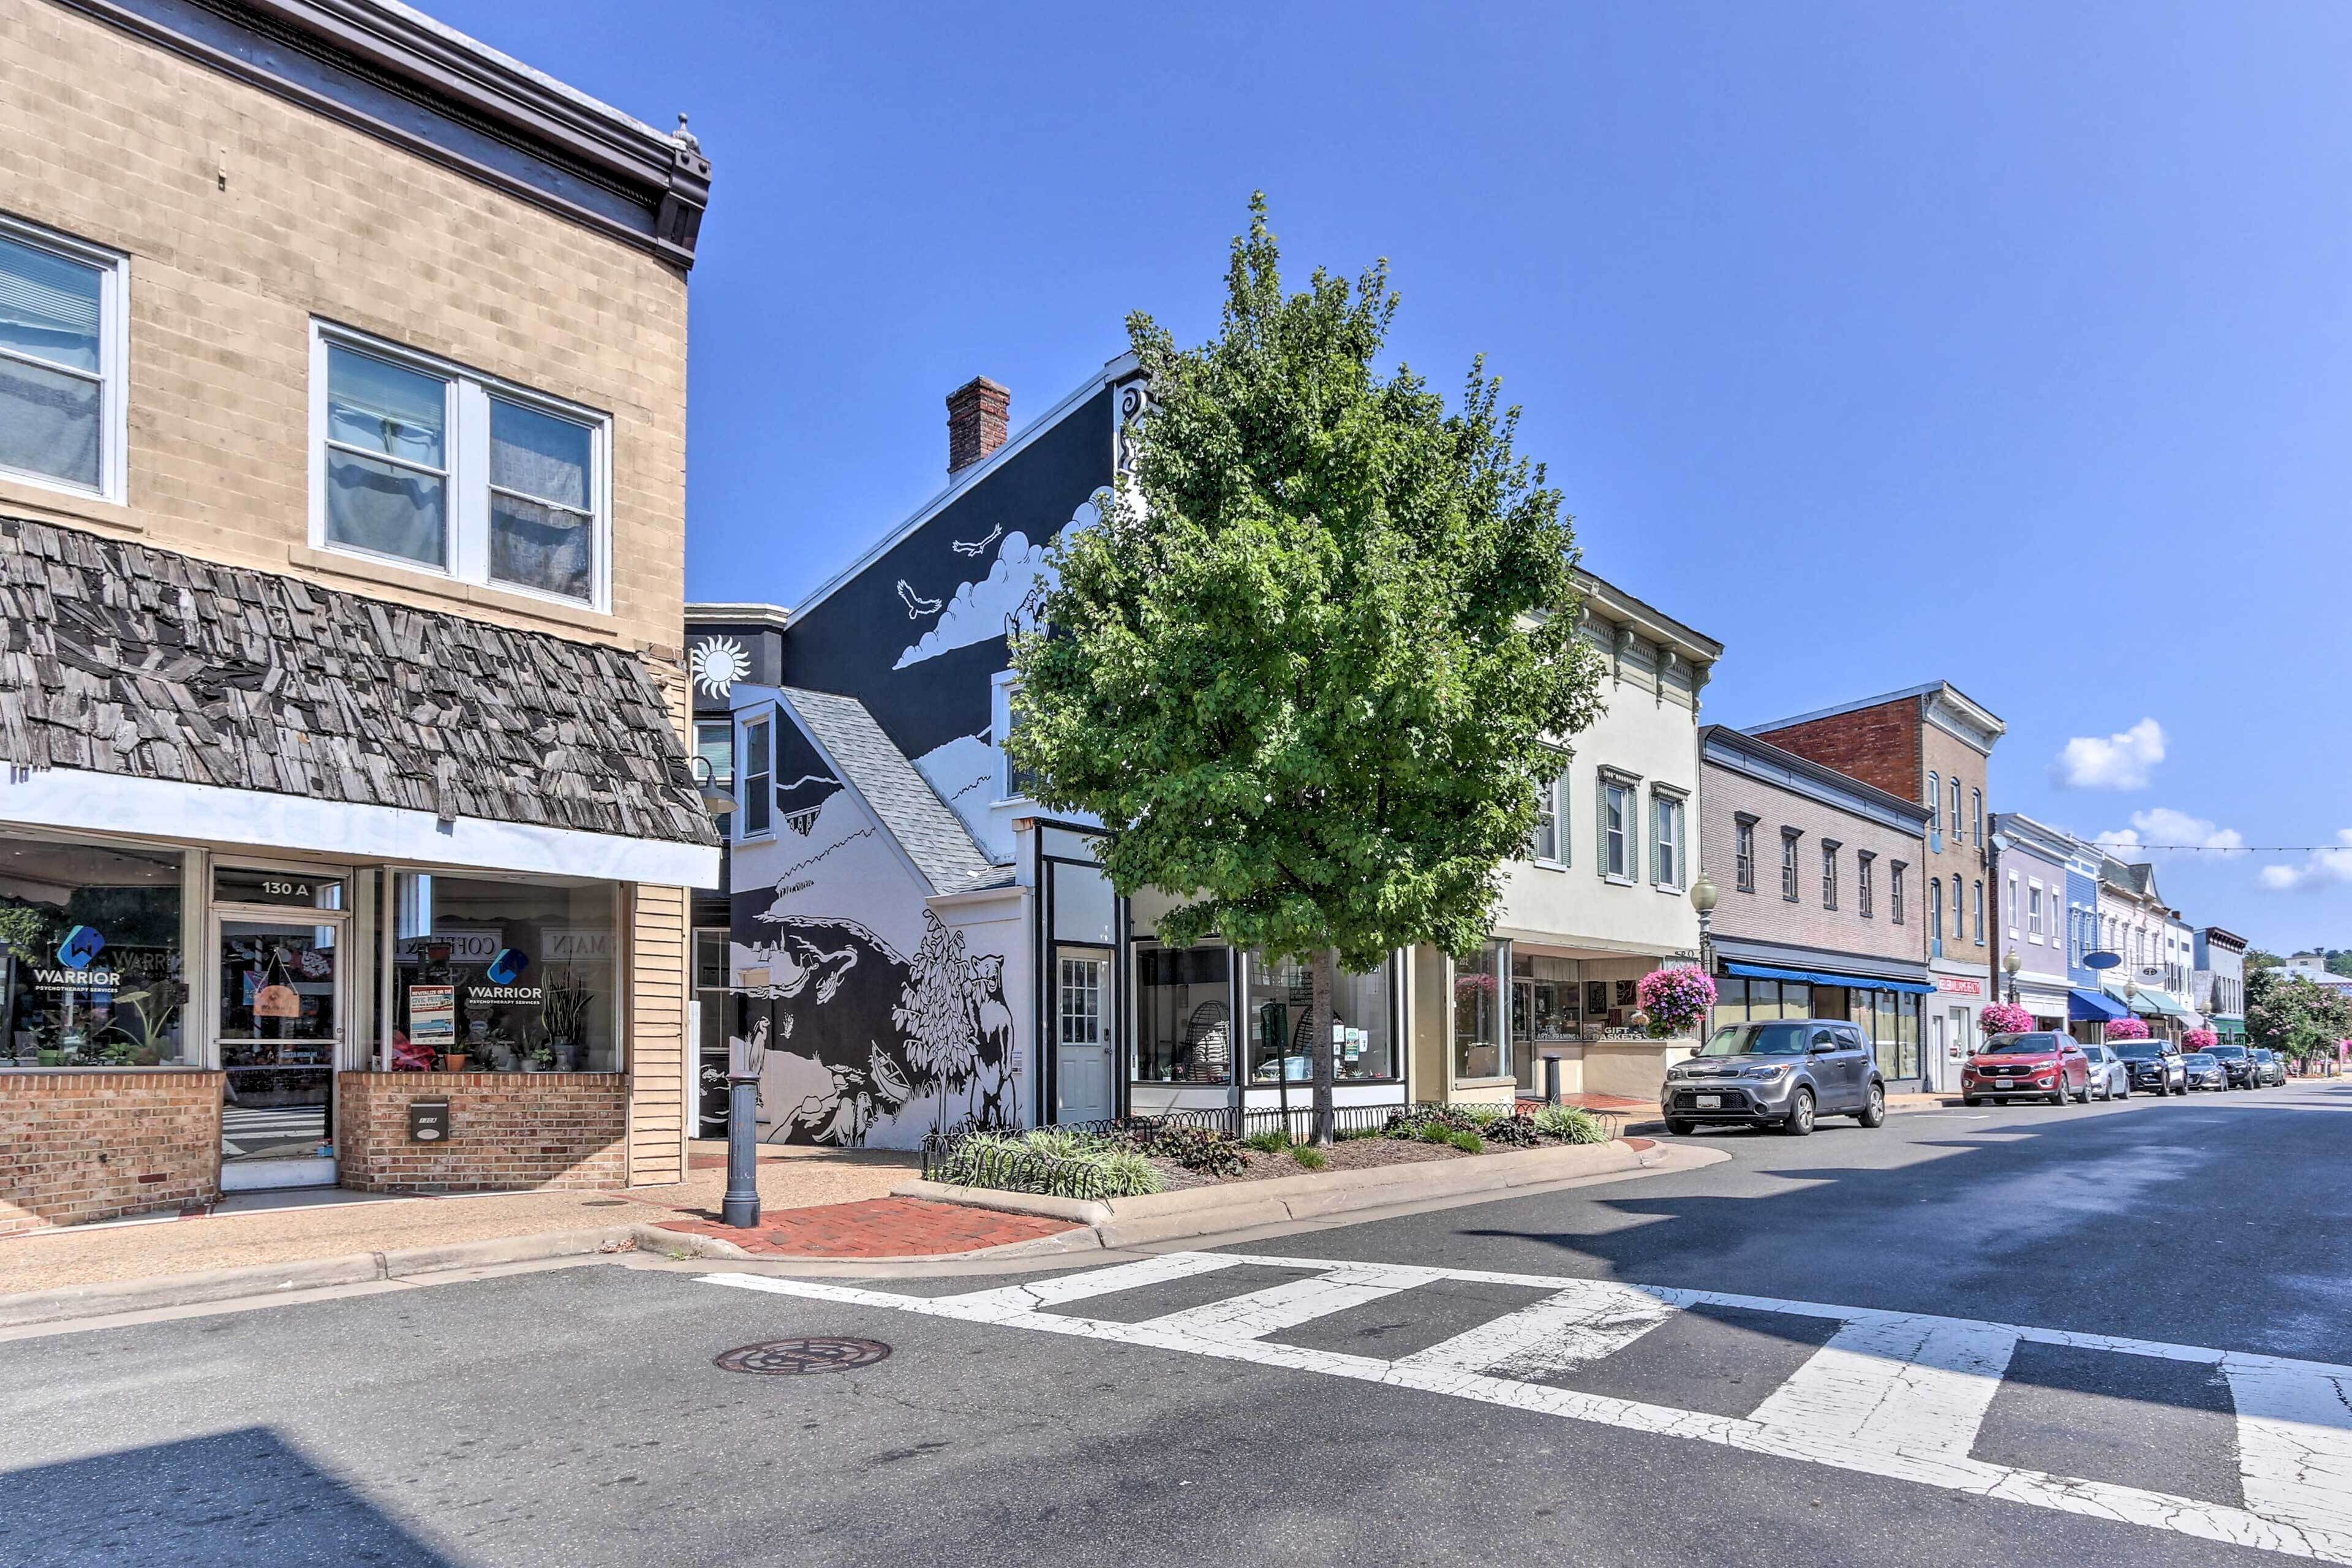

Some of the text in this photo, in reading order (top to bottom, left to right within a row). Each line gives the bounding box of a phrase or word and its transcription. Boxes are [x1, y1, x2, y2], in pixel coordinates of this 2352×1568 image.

[262, 881, 309, 896] 130 A
[34, 970, 121, 986] WARRIOR
[467, 986, 543, 999] WARRIOR
